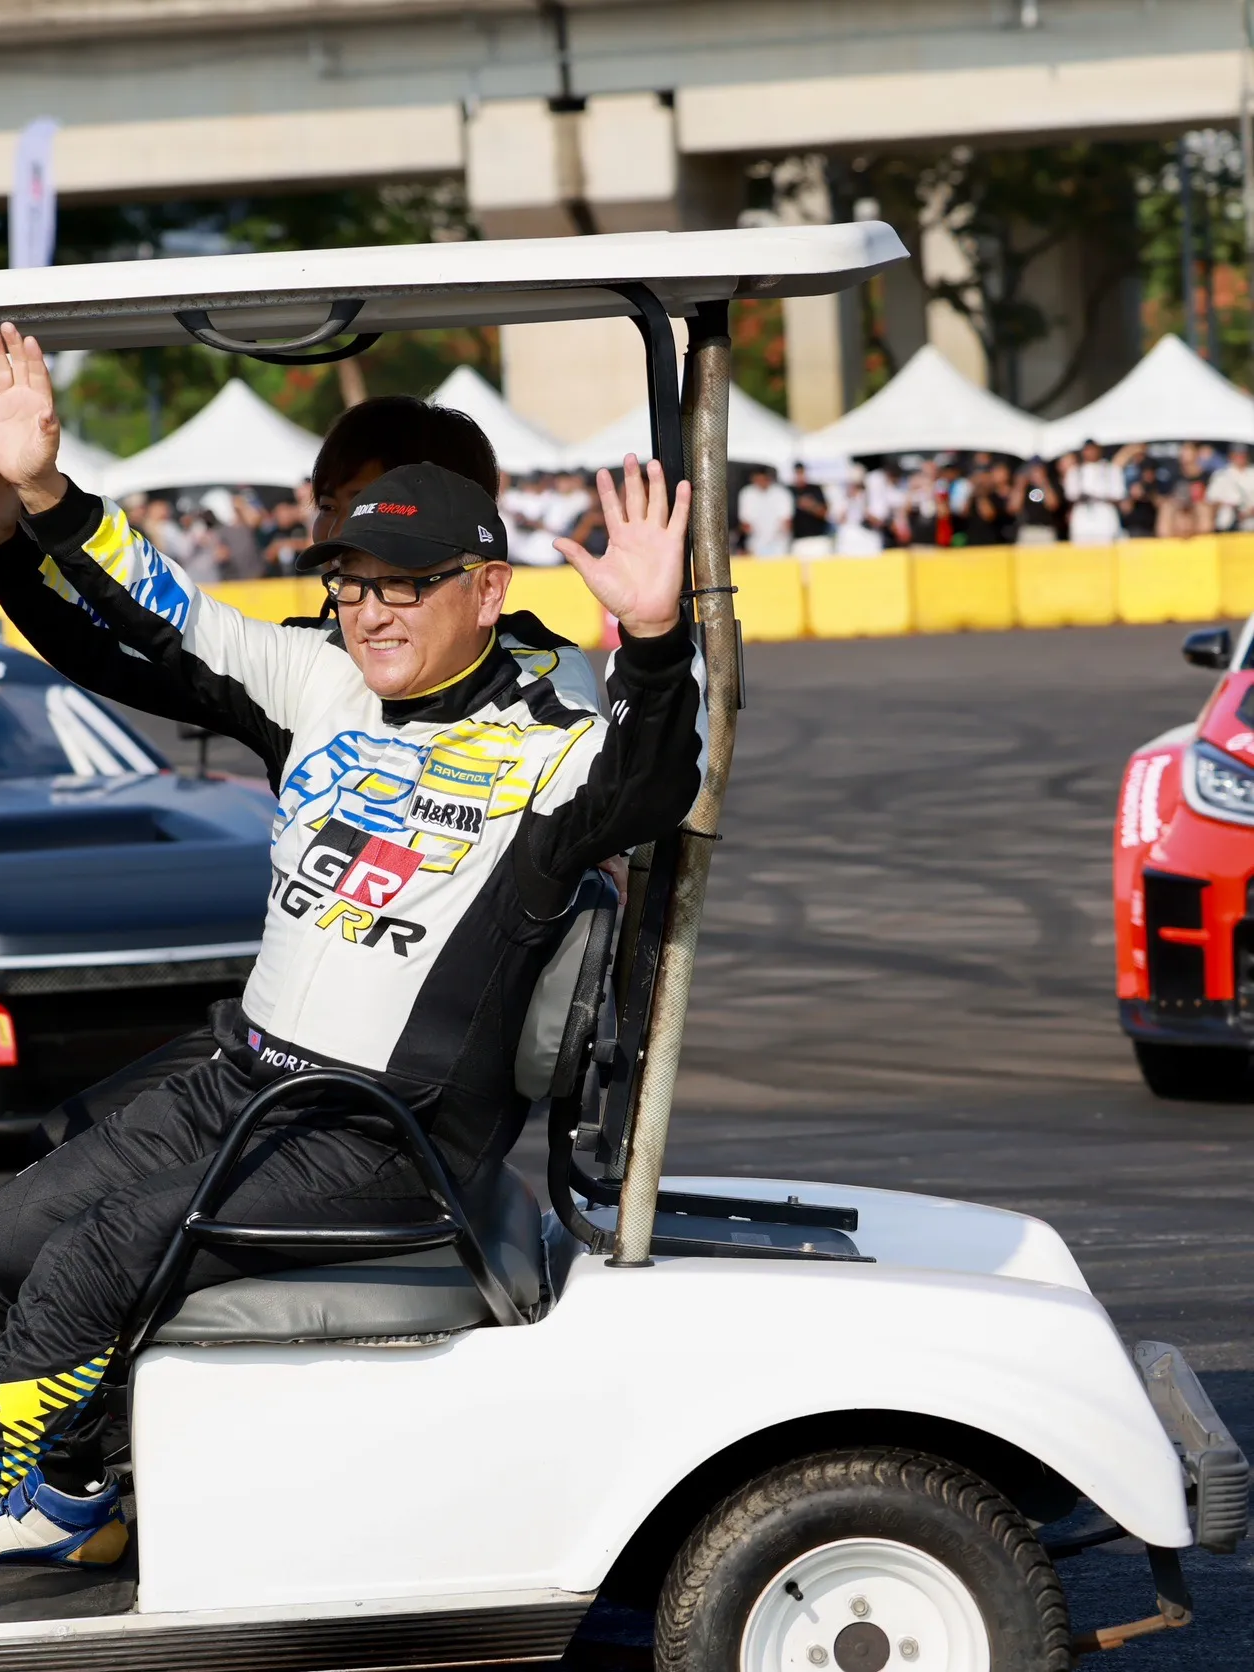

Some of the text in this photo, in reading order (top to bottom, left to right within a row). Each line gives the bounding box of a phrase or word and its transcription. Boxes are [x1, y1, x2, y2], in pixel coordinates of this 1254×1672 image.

[433, 764, 487, 783] RAVENOL
[301, 844, 403, 907] GR
[259, 1046, 323, 1073] MORI
